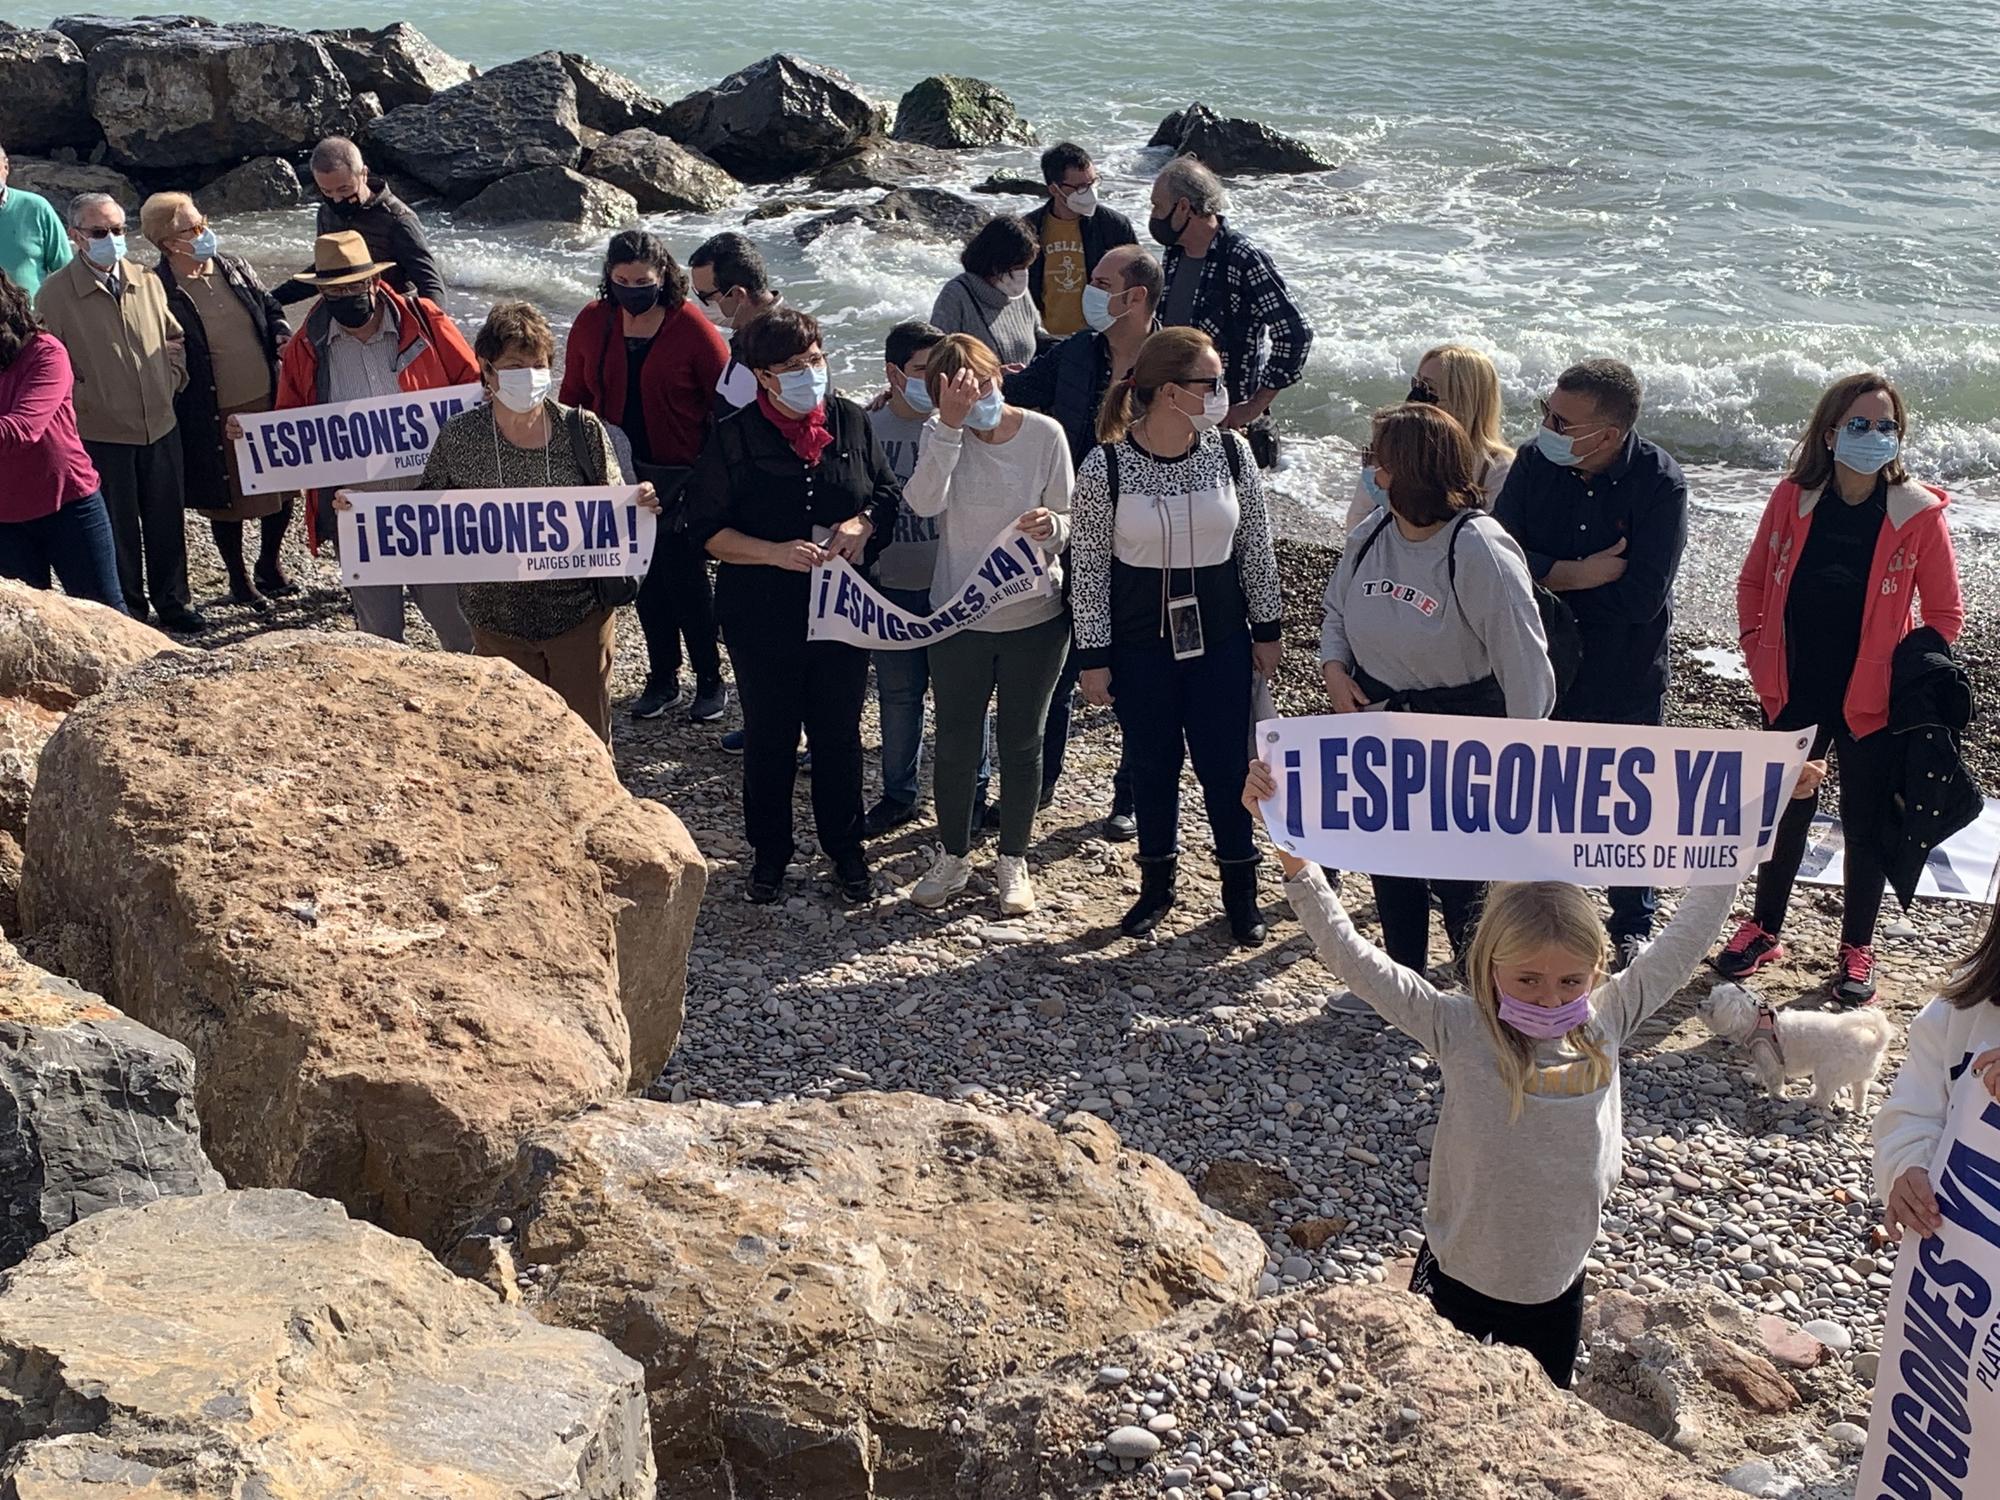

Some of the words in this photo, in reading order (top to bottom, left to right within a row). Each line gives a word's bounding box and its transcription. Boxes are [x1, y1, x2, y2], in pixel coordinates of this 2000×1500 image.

[261, 403, 430, 468] ESPIGONES
[376, 501, 569, 557] ESPIGONES
[579, 500, 619, 549] YA
[527, 556, 570, 571] PLATGES
[572, 554, 586, 568] DE
[588, 553, 621, 568] NULES
[834, 570, 985, 642] ESPIGONES
[978, 546, 1024, 588] YA
[956, 604, 991, 629] PLATGES
[990, 593, 1004, 605] DE
[1002, 577, 1033, 597] NULES
[1319, 735, 1656, 835] ESPIGONES
[1675, 749, 1742, 837] YA
[1573, 843, 1646, 869] PLATGES
[1653, 845, 1679, 869] DE
[1683, 845, 1738, 869] NULES
[1876, 1231, 1992, 1500] PIGONES
